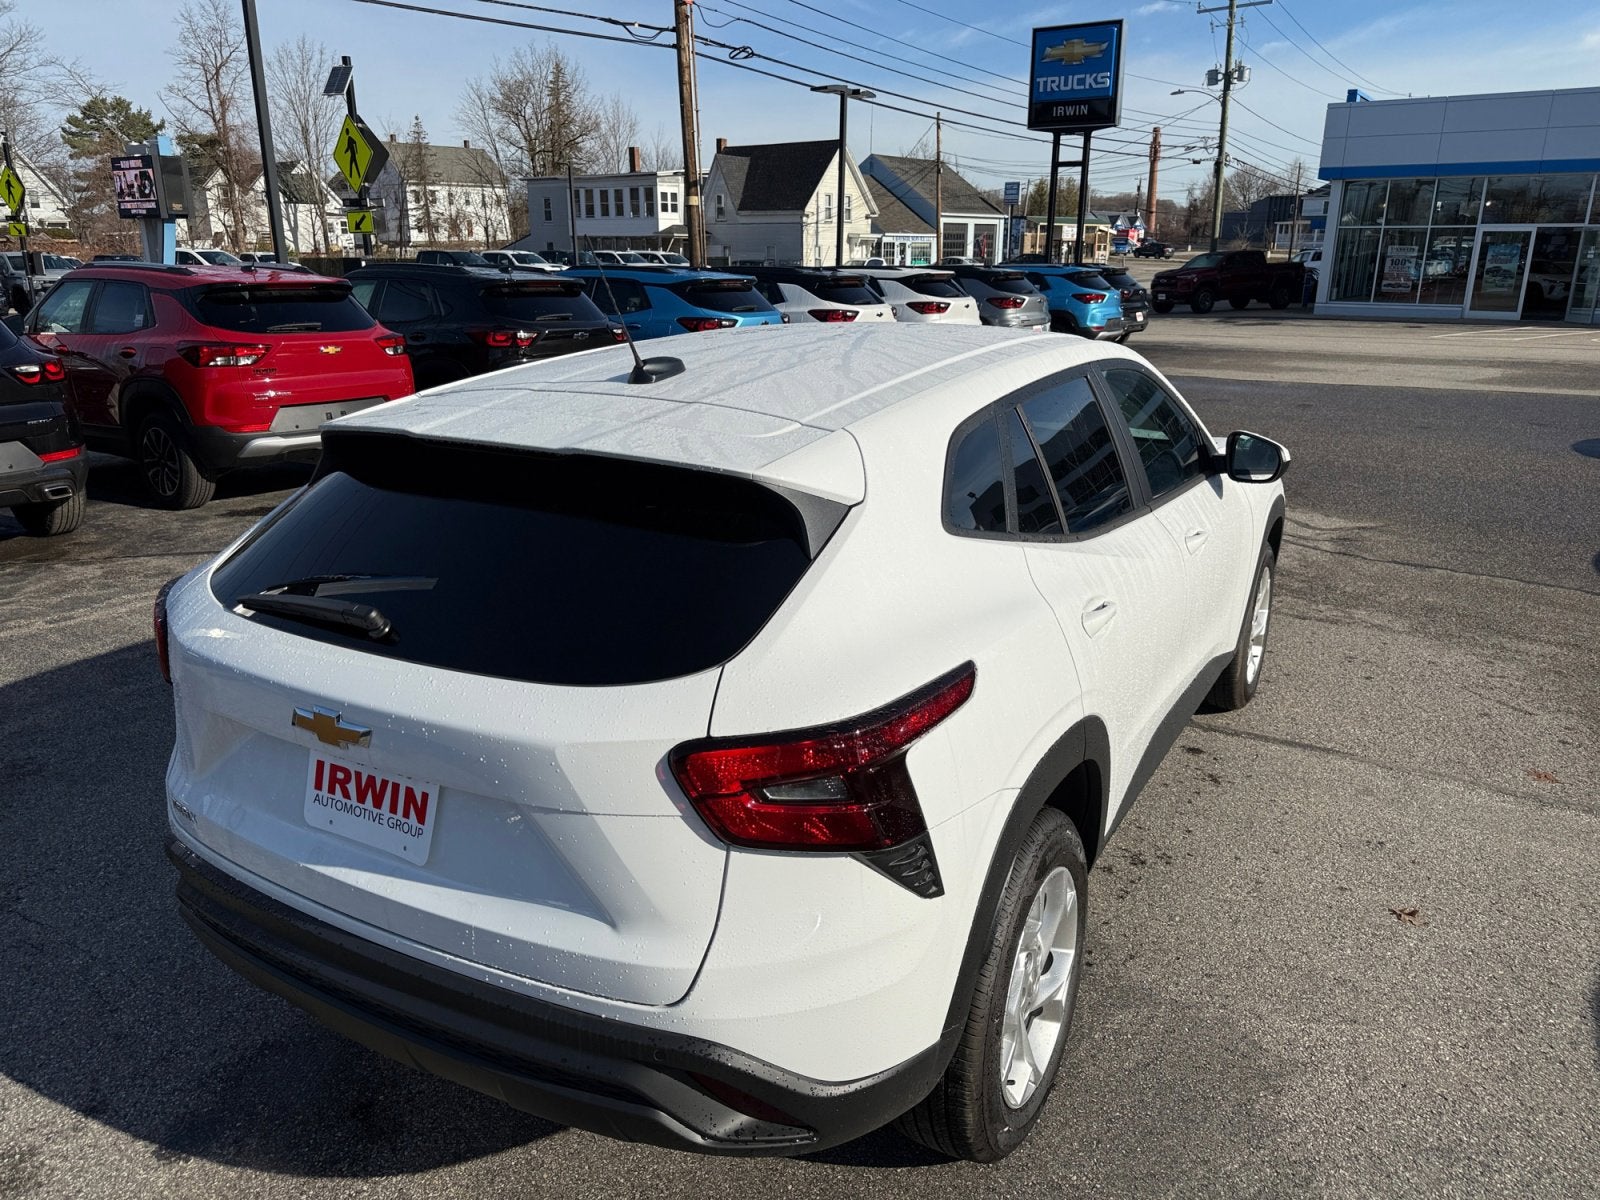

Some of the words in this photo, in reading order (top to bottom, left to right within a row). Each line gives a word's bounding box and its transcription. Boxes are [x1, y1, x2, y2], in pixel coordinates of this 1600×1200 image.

[1036, 72, 1110, 92] TRUCKS
[1053, 104, 1089, 117] IRWIN
[314, 759, 430, 826] IRWIN
[313, 793, 385, 826] AUTOMOTIVE
[386, 816, 424, 839] GROUP
